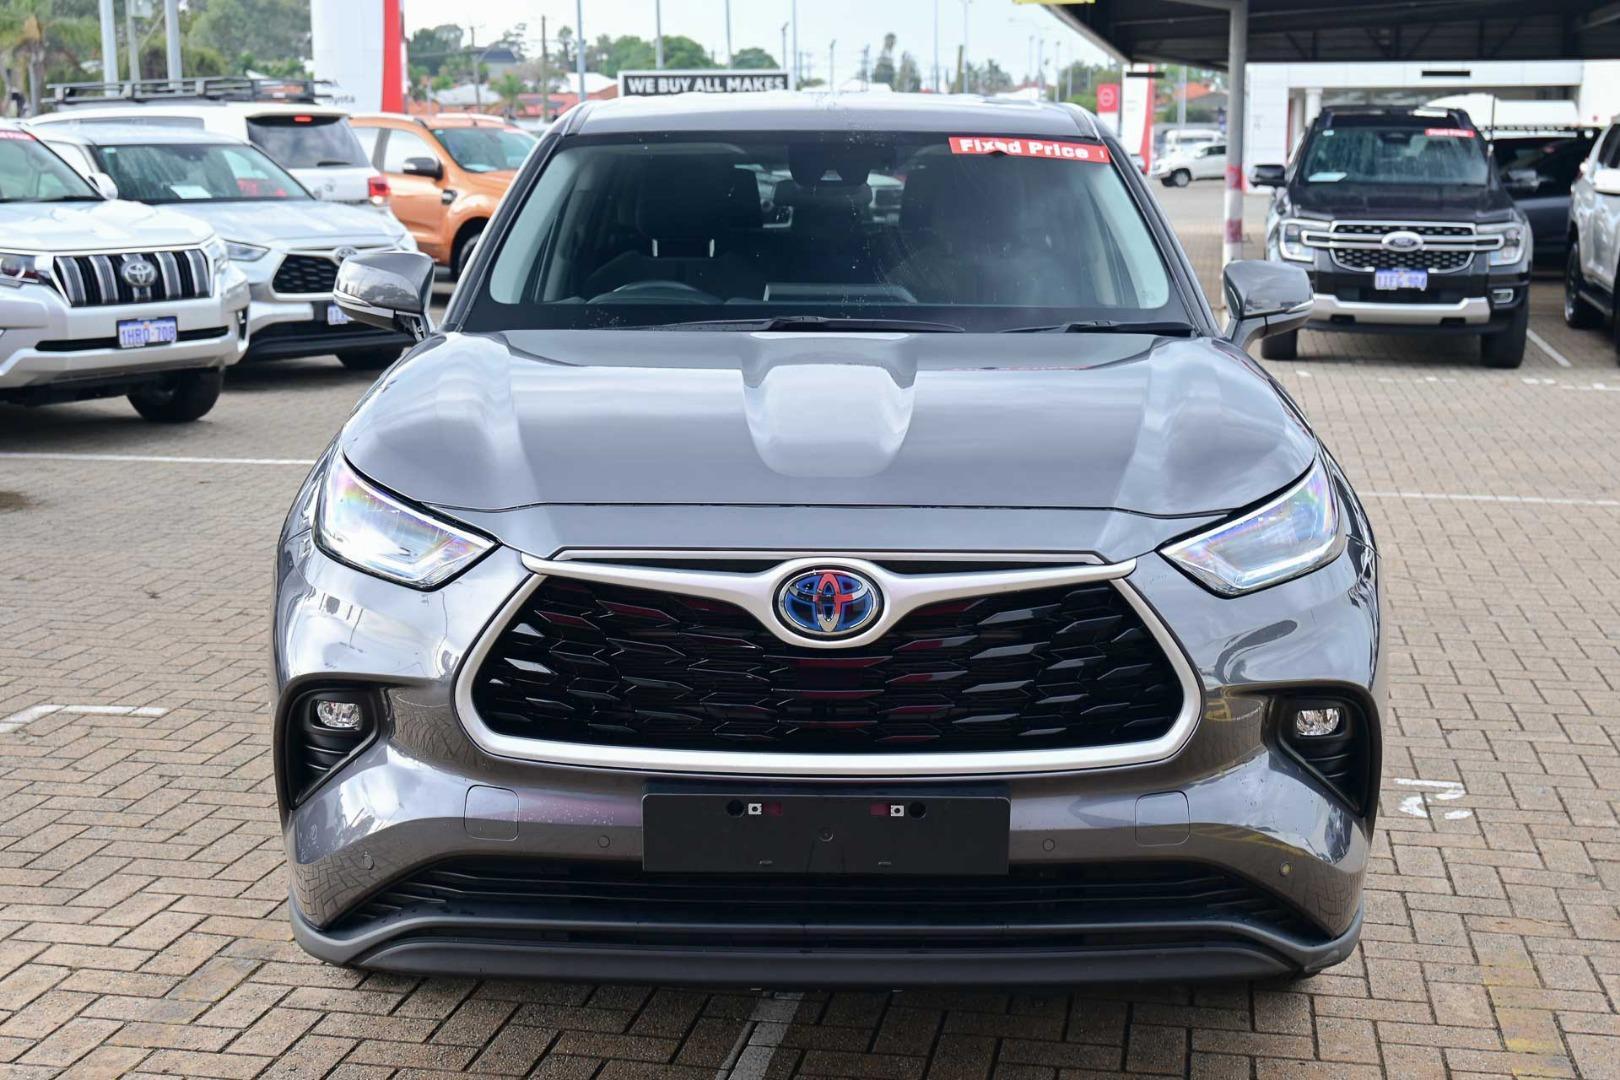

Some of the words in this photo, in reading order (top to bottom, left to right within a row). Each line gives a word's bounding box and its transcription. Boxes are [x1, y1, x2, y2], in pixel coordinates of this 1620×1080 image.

[627, 78, 655, 94] WE
[658, 78, 692, 93] BUY
[693, 78, 723, 93] ALL
[726, 77, 785, 92] MAKES
[1028, 141, 1089, 159] Price
